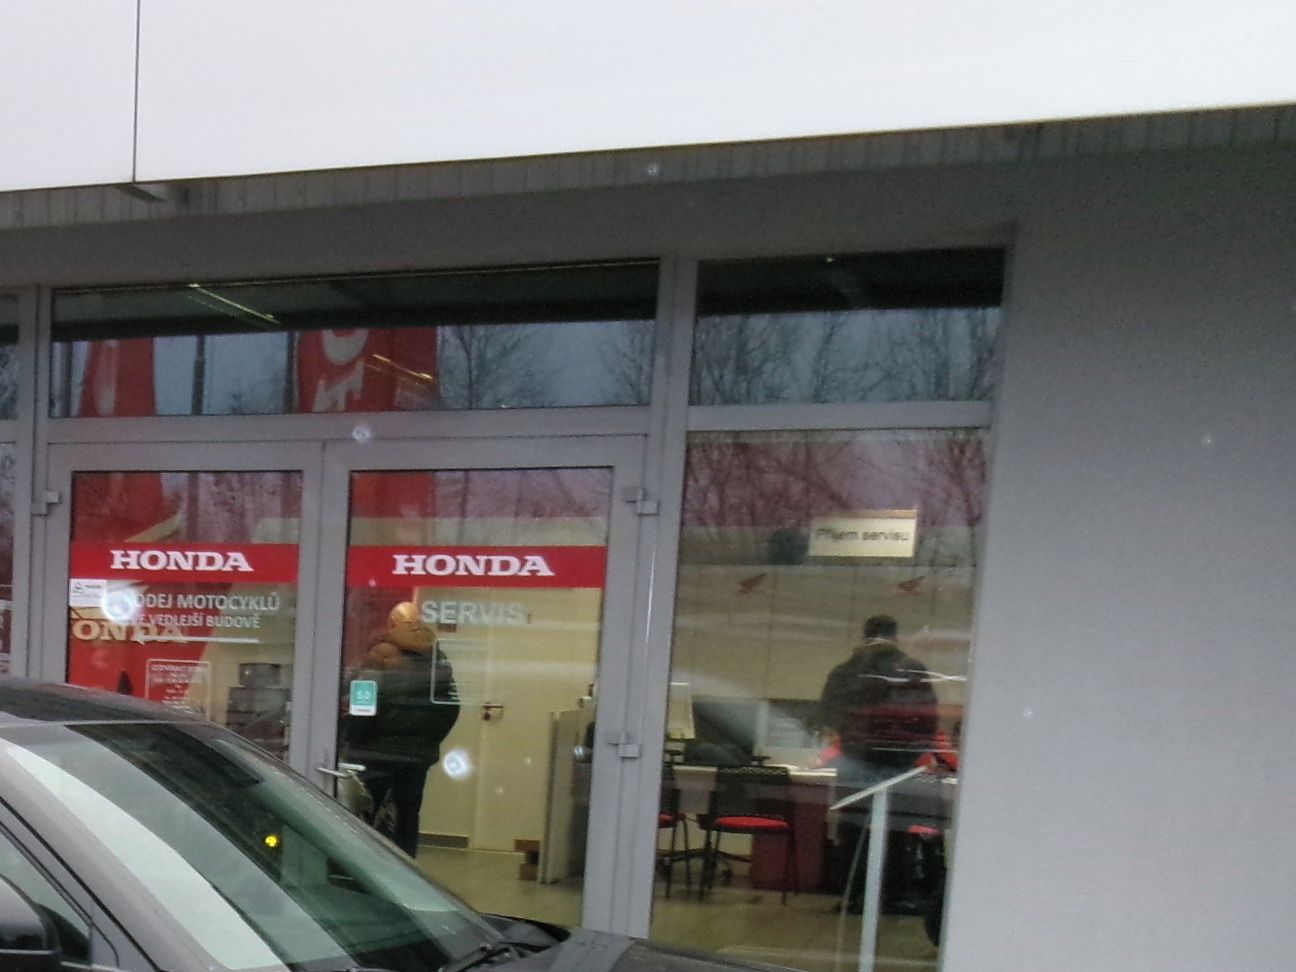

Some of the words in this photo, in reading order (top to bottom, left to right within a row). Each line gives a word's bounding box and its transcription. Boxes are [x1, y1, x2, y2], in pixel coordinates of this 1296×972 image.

[110, 550, 254, 572] HONDA
[392, 554, 555, 576] HONDA
[177, 591, 281, 611] MOTOCYKLŮ
[206, 613, 261, 629] BUDOVĚ
[421, 600, 523, 625] SERVIS
[72, 620, 190, 643] ONDA
